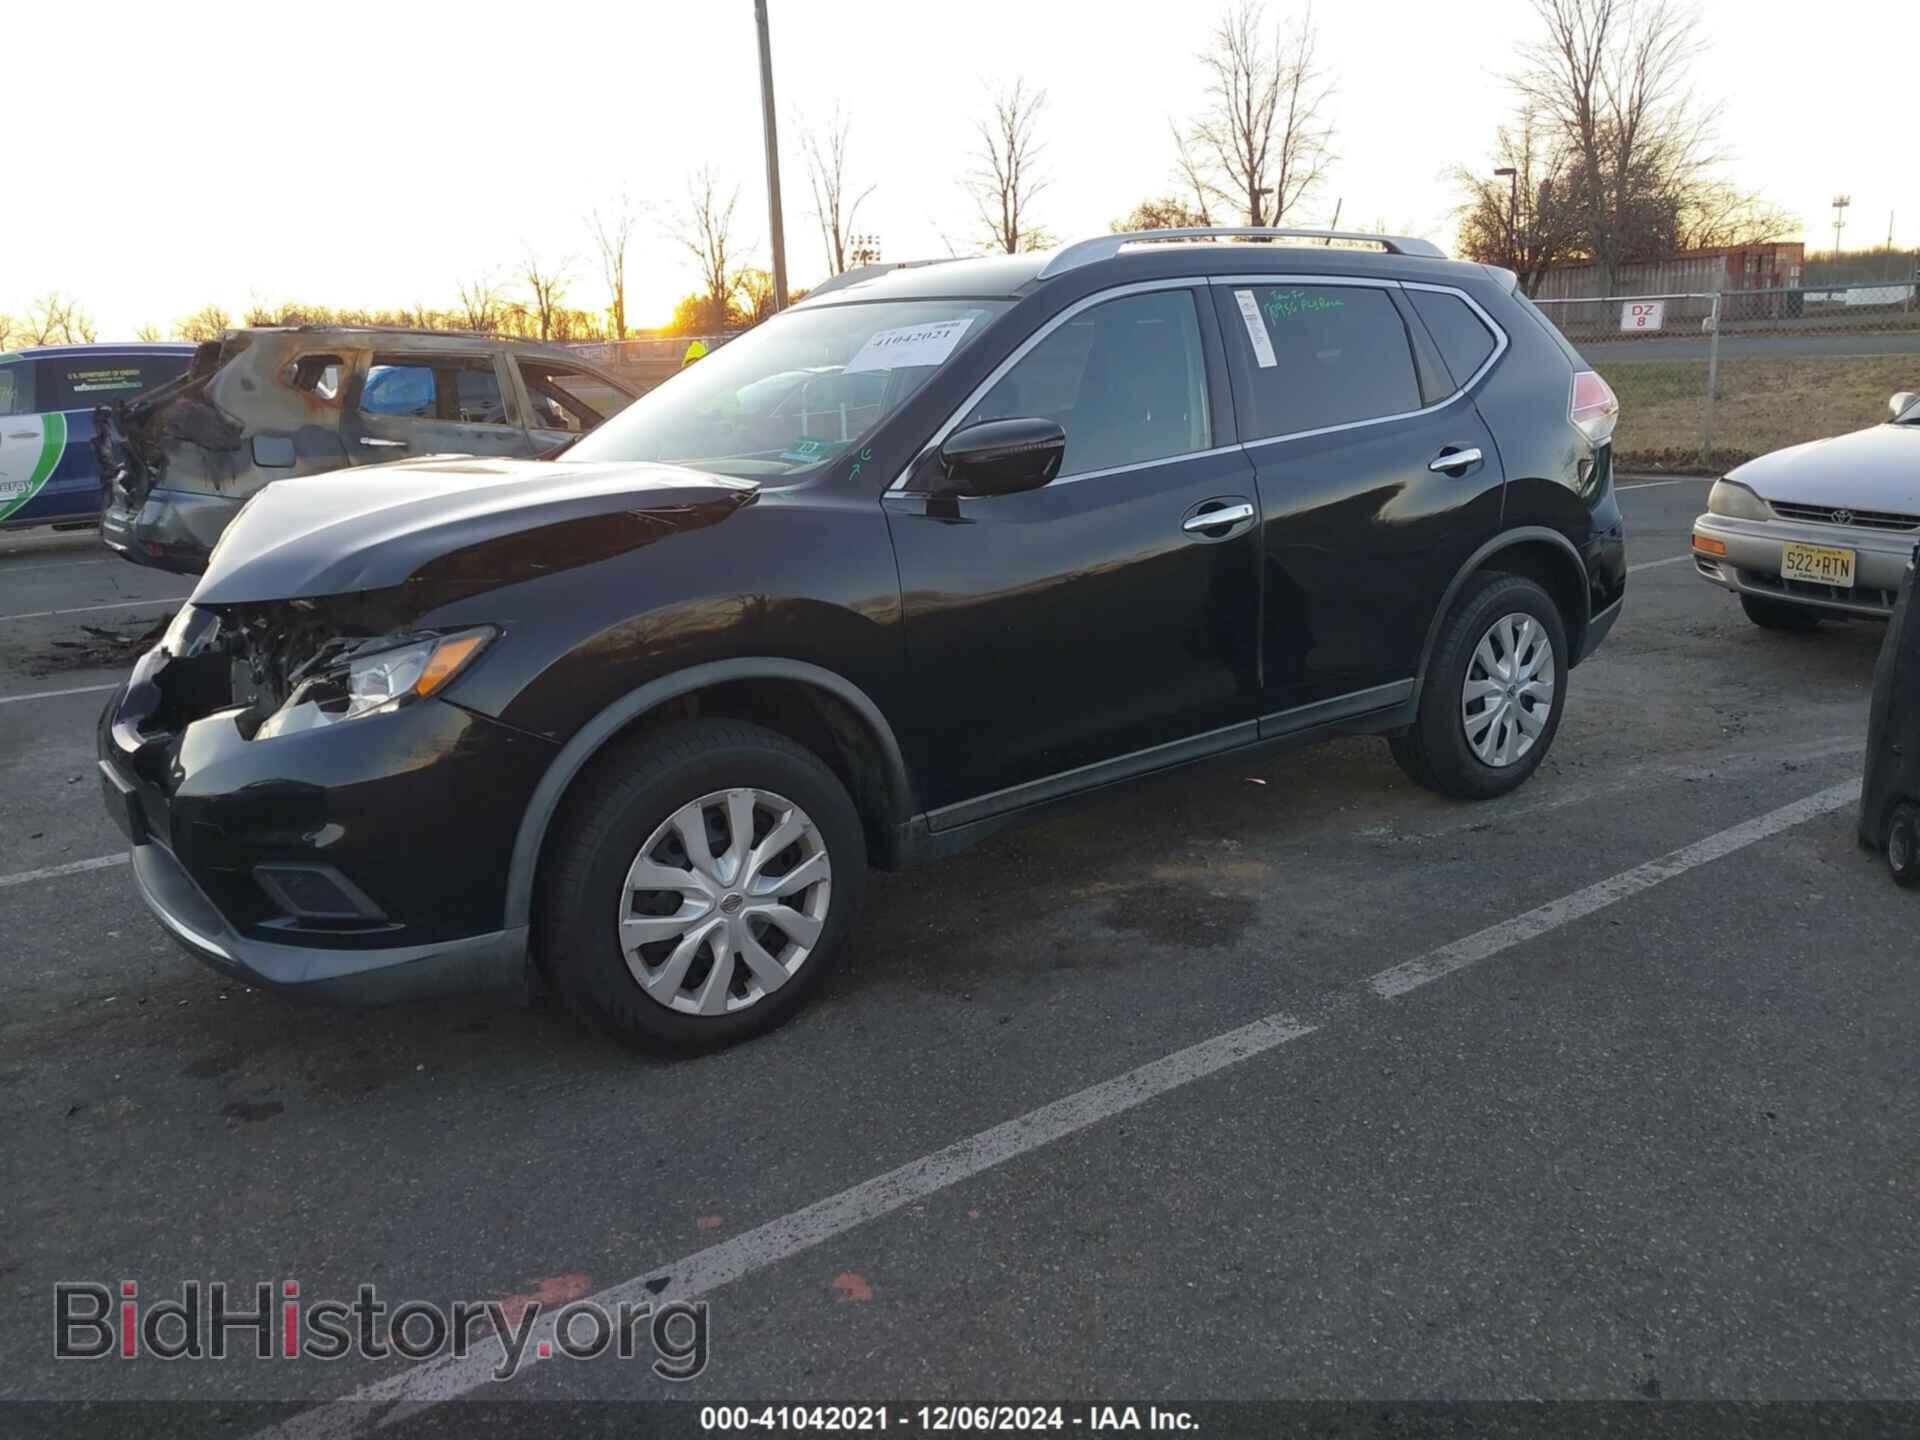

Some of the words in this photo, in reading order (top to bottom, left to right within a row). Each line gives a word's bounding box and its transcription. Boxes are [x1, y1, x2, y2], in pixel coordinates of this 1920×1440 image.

[1632, 304, 1655, 316] DZ
[1637, 316, 1646, 327] 8
[872, 330, 950, 346] 41042021
